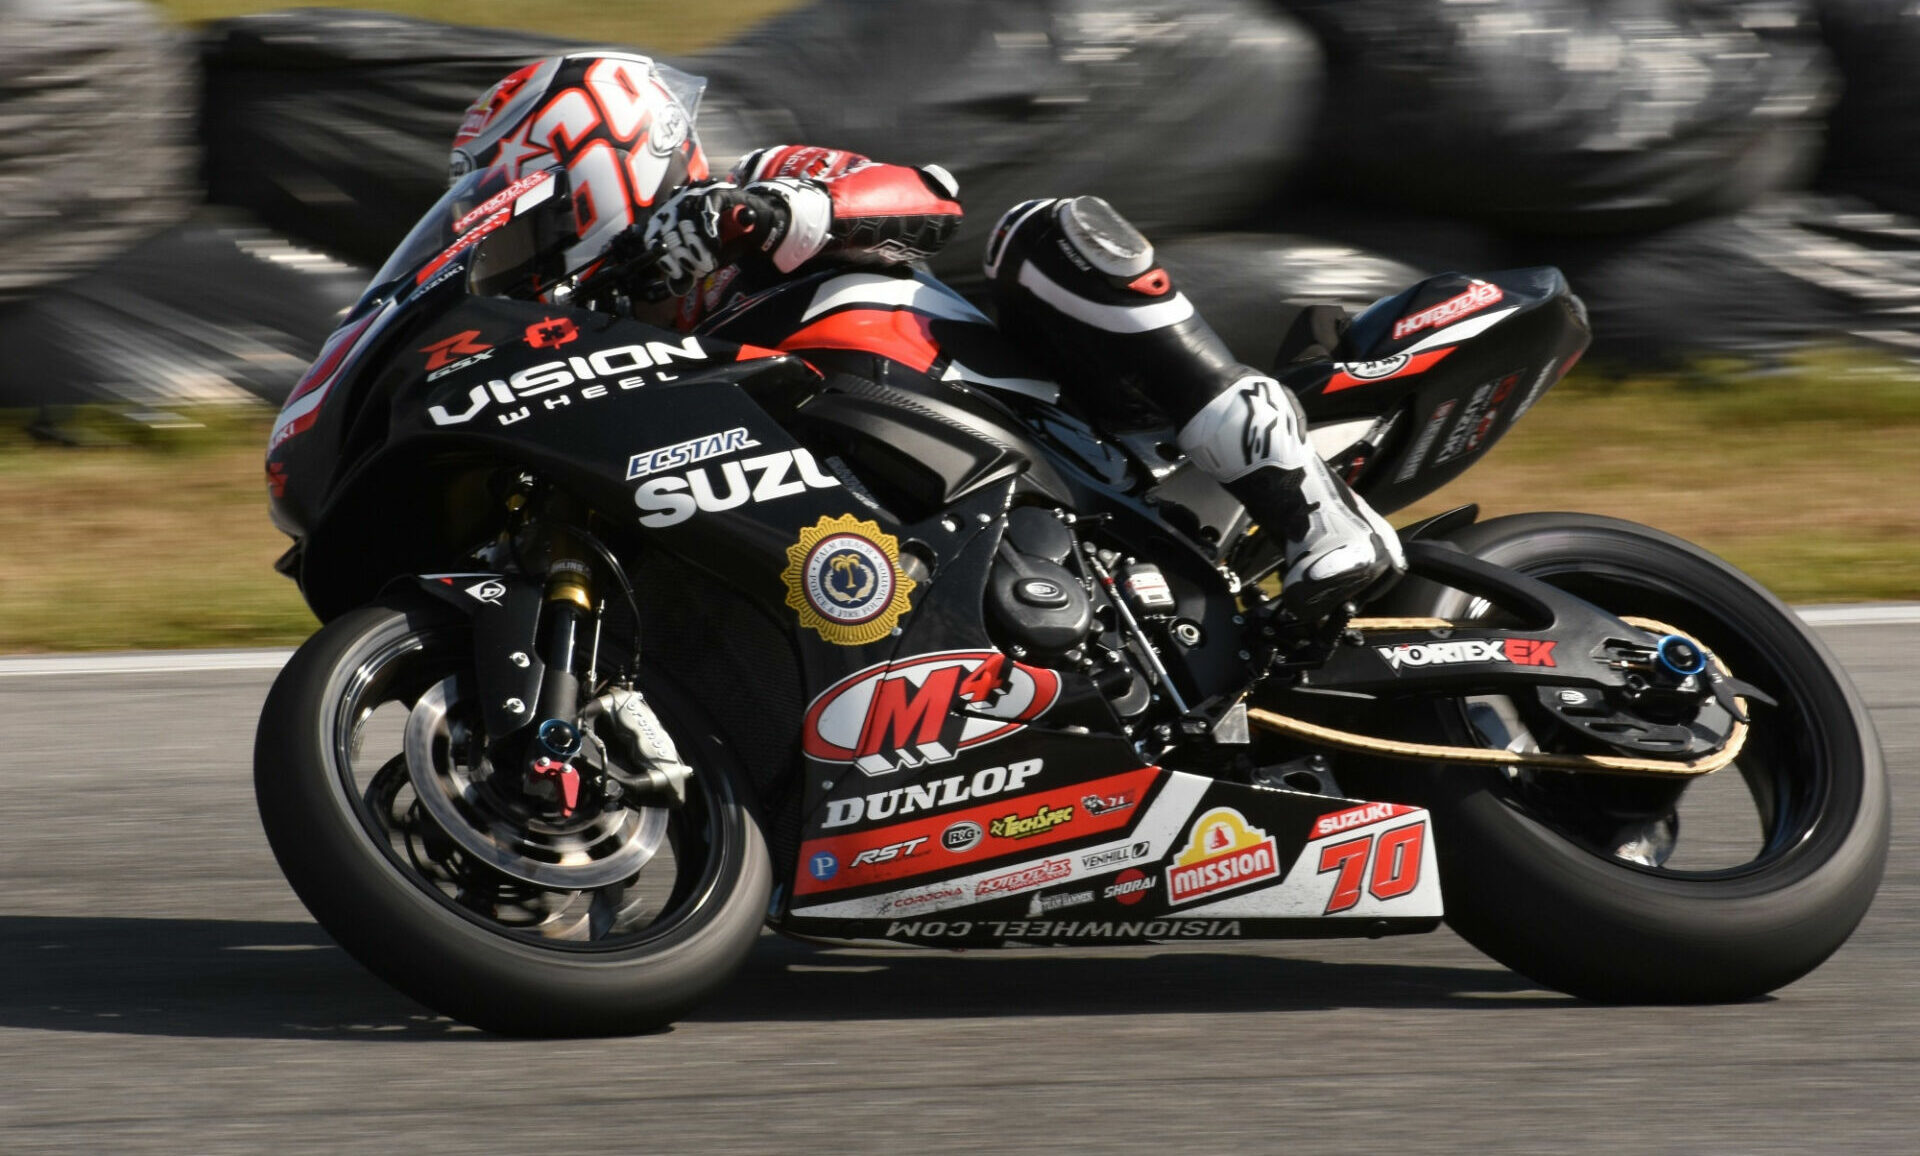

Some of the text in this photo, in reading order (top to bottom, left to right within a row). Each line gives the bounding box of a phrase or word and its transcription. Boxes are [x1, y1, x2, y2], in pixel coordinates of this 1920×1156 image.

[428, 336, 708, 426] VISION
[498, 371, 679, 426] WHEEL
[627, 427, 762, 479] ECSTAR
[821, 758, 1043, 828] DUNLOP
[1317, 803, 1394, 834] SUZUKI
[850, 836, 929, 868] RST
[949, 829, 975, 844] R&G
[815, 857, 833, 877] P
[1081, 848, 1129, 867] VENHILL
[1317, 819, 1427, 916] 70
[894, 887, 963, 907] CORDONA
[1103, 875, 1157, 899] SHORAI
[886, 919, 1242, 938] VISIONWHEEL.COM
